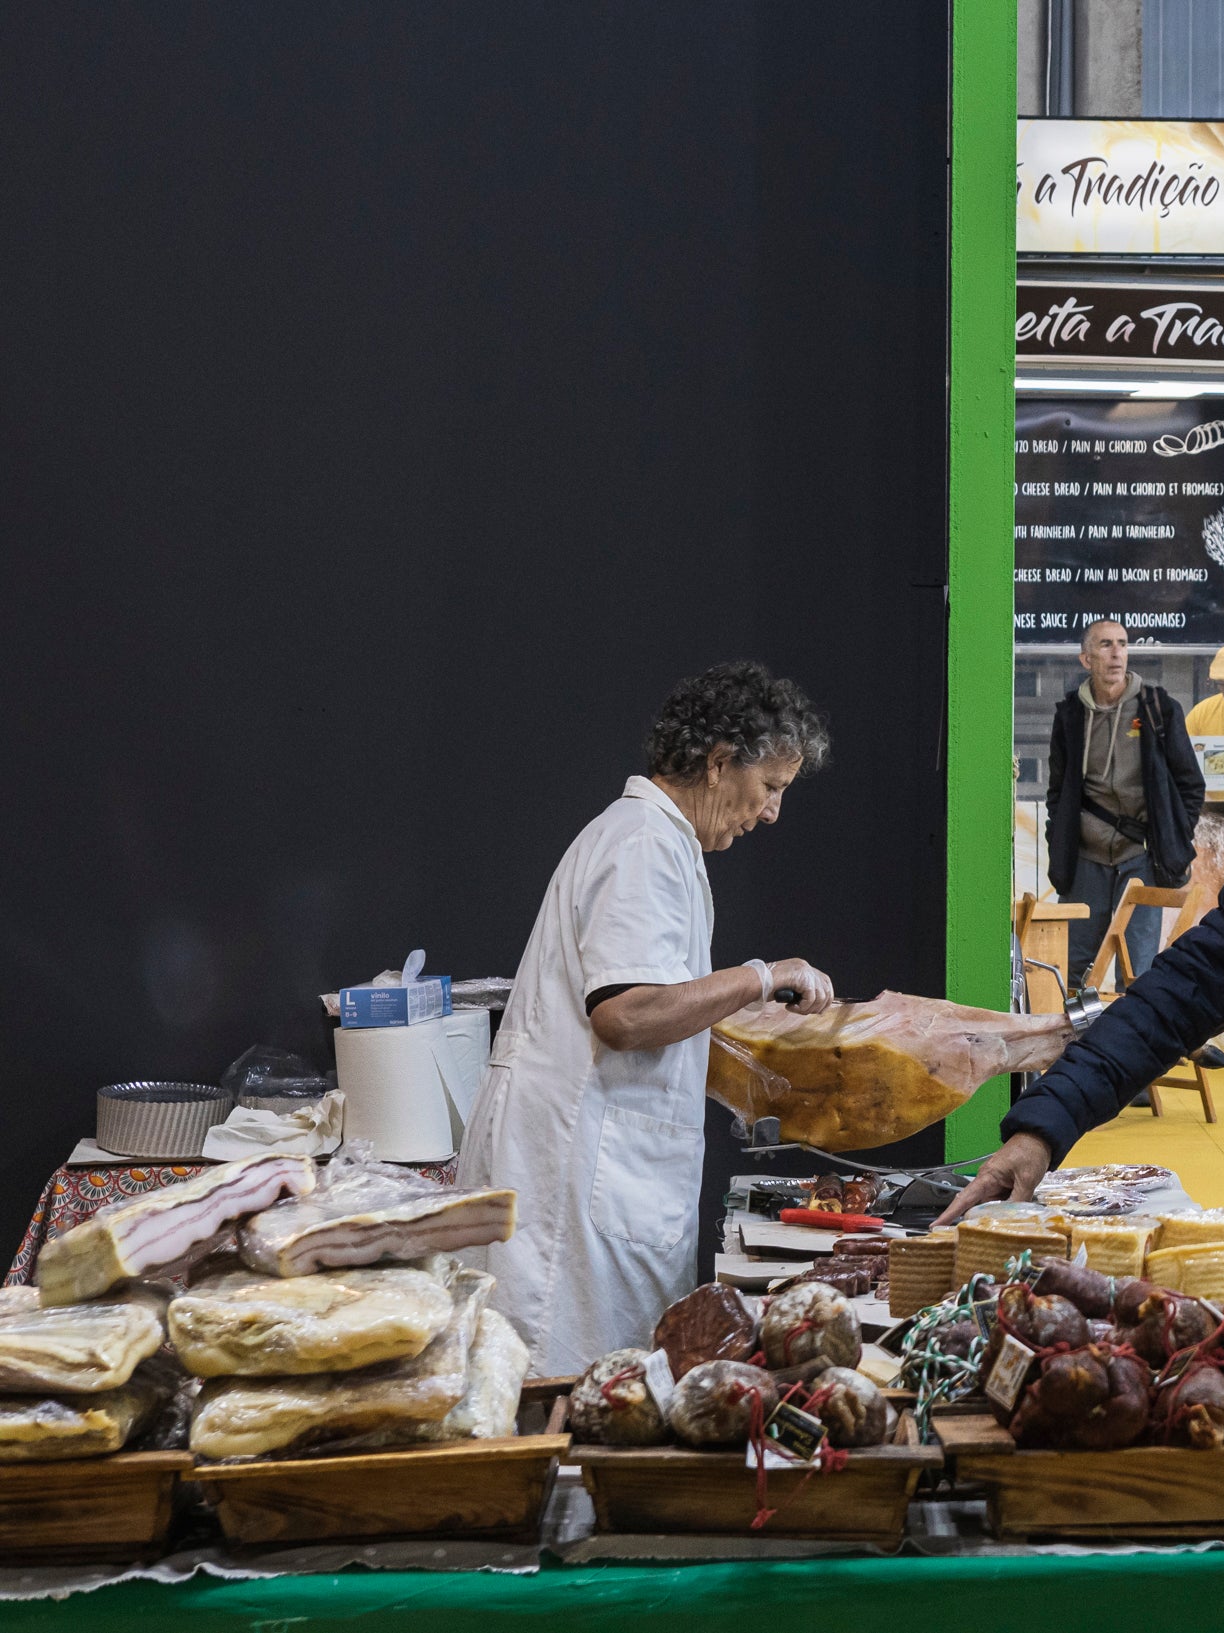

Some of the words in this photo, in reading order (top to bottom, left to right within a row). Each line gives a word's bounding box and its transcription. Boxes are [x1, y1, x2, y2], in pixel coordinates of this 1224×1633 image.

[1034, 173, 1057, 204] a
[1061, 156, 1221, 218] Tradição
[1105, 314, 1137, 343] a
[1033, 440, 1058, 453] BREAD
[1062, 440, 1067, 453] /
[1071, 440, 1091, 453] PAIN
[1094, 440, 1105, 453] AU
[1109, 440, 1147, 453] CHORIZO)
[1022, 482, 1050, 496] CHEESE
[1054, 482, 1080, 496] BREAD
[1084, 483, 1089, 496] /
[1093, 482, 1112, 496] PAIN
[1116, 482, 1127, 496] AU
[1131, 482, 1166, 496] CHORIZO
[1169, 483, 1179, 496] ET
[1182, 482, 1224, 496] FROMAGE)
[1031, 525, 1076, 538] FARINHEIRA
[1079, 525, 1085, 538] /
[1088, 525, 1108, 538] PAIN
[1112, 525, 1122, 538] AU
[1126, 525, 1175, 538] FARINHEIRA)
[1014, 568, 1041, 582] CHEESE
[1046, 568, 1071, 582] BREAD
[1075, 569, 1081, 582] /
[1084, 568, 1104, 582] PAIN
[1108, 568, 1118, 582] AU
[1122, 568, 1150, 582] BACON
[1153, 568, 1163, 582] ET
[1166, 568, 1208, 582] FROMAGE)
[1041, 613, 1067, 628] SAUCE
[1072, 613, 1078, 628] /
[1125, 612, 1186, 629] BOLOGNAISE)
[345, 992, 356, 1005] L
